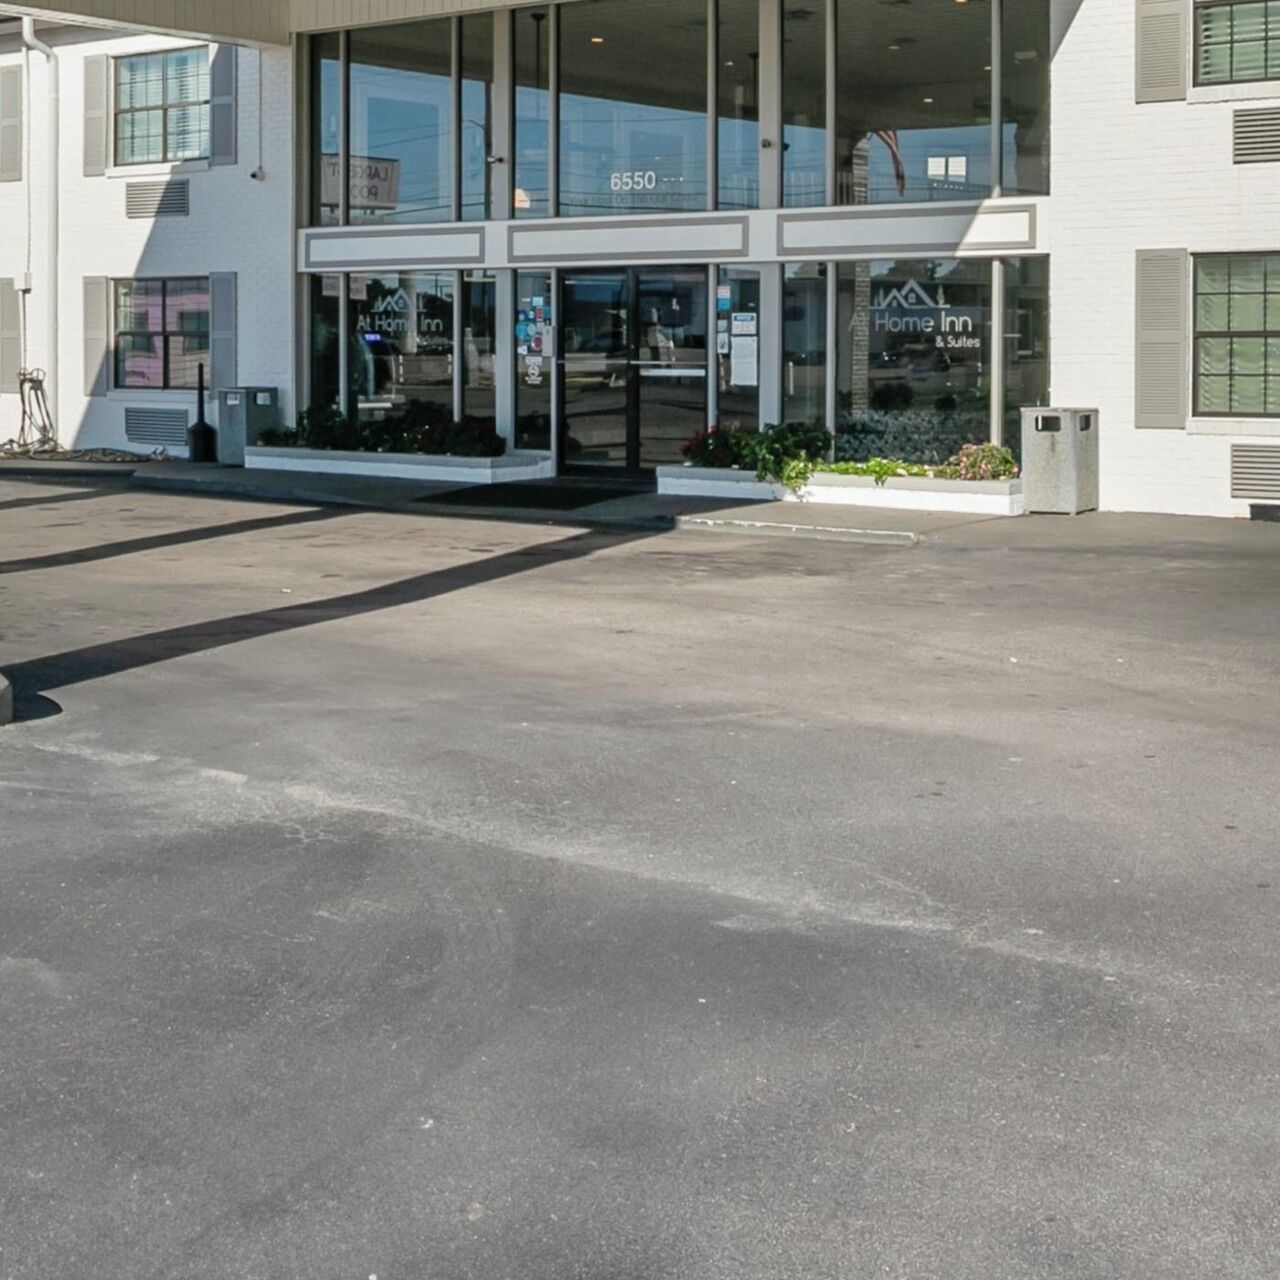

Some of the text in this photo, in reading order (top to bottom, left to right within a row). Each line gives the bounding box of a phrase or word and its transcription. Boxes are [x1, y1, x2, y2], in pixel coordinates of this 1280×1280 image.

[610, 170, 657, 191] 6550
[357, 314, 371, 331] At
[421, 314, 443, 331] Inn
[875, 311, 935, 332] Home
[941, 310, 973, 332] Inn
[935, 334, 981, 348] & Suites
